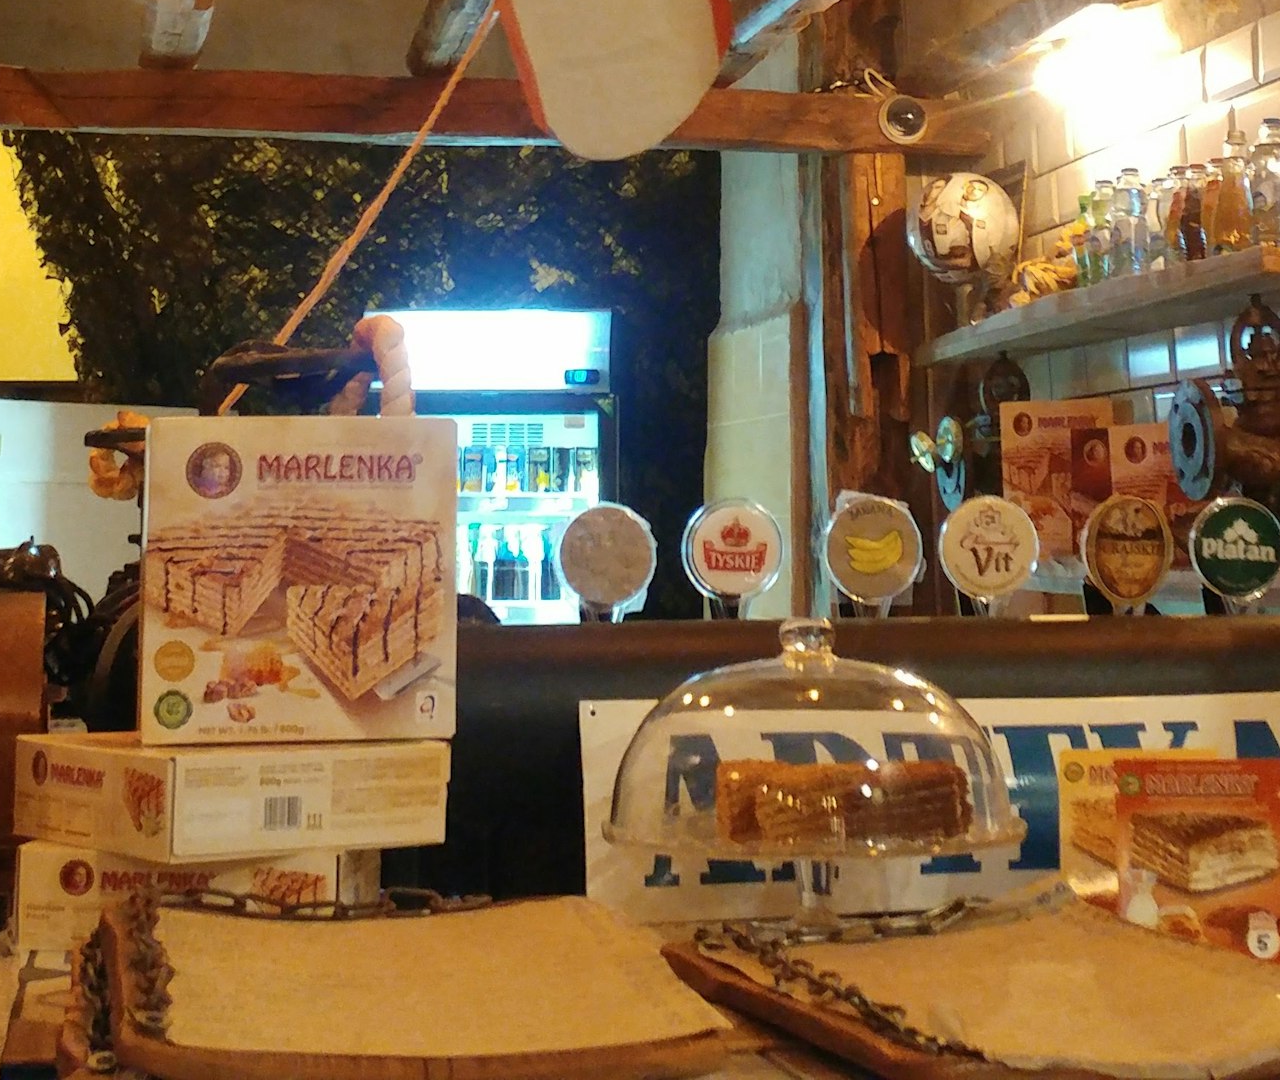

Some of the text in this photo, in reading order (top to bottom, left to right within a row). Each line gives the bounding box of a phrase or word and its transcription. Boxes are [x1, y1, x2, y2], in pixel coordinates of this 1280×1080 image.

[257, 454, 417, 483] MARLENKA
[710, 551, 761, 569] TYSKIE
[1201, 537, 1277, 562] Platan
